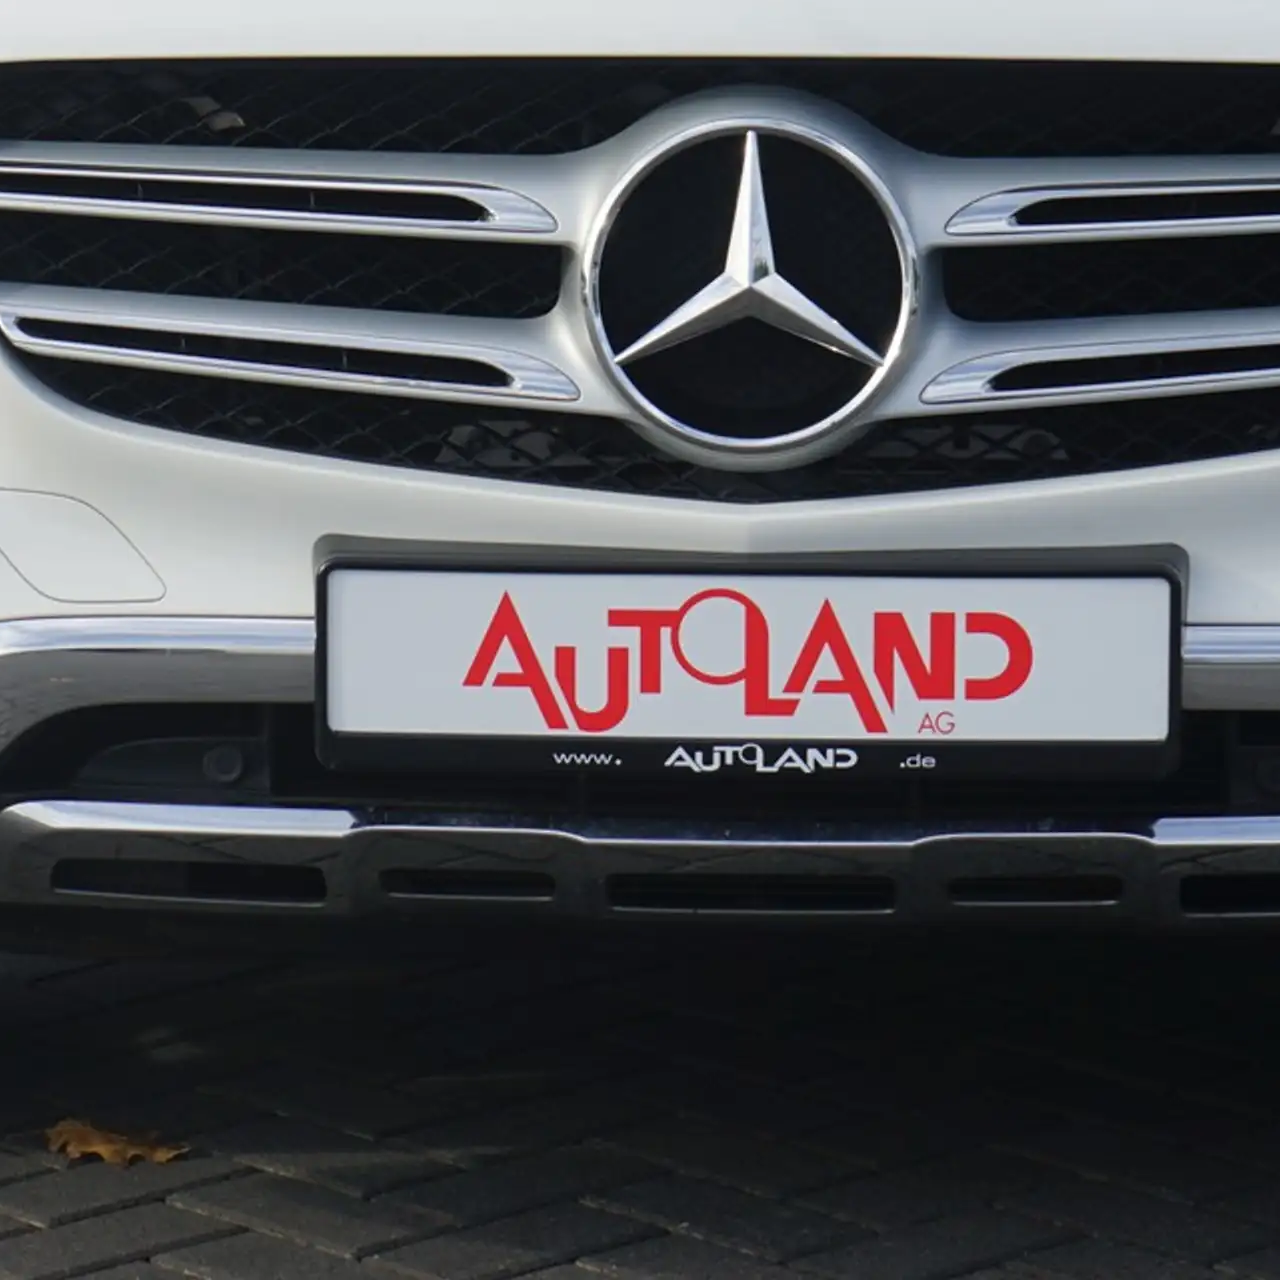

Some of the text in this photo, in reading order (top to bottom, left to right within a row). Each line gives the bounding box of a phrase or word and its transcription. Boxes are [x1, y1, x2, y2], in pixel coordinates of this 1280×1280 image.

[917, 710, 956, 735] AG
[552, 751, 622, 766] www.
[899, 753, 936, 768] .de
